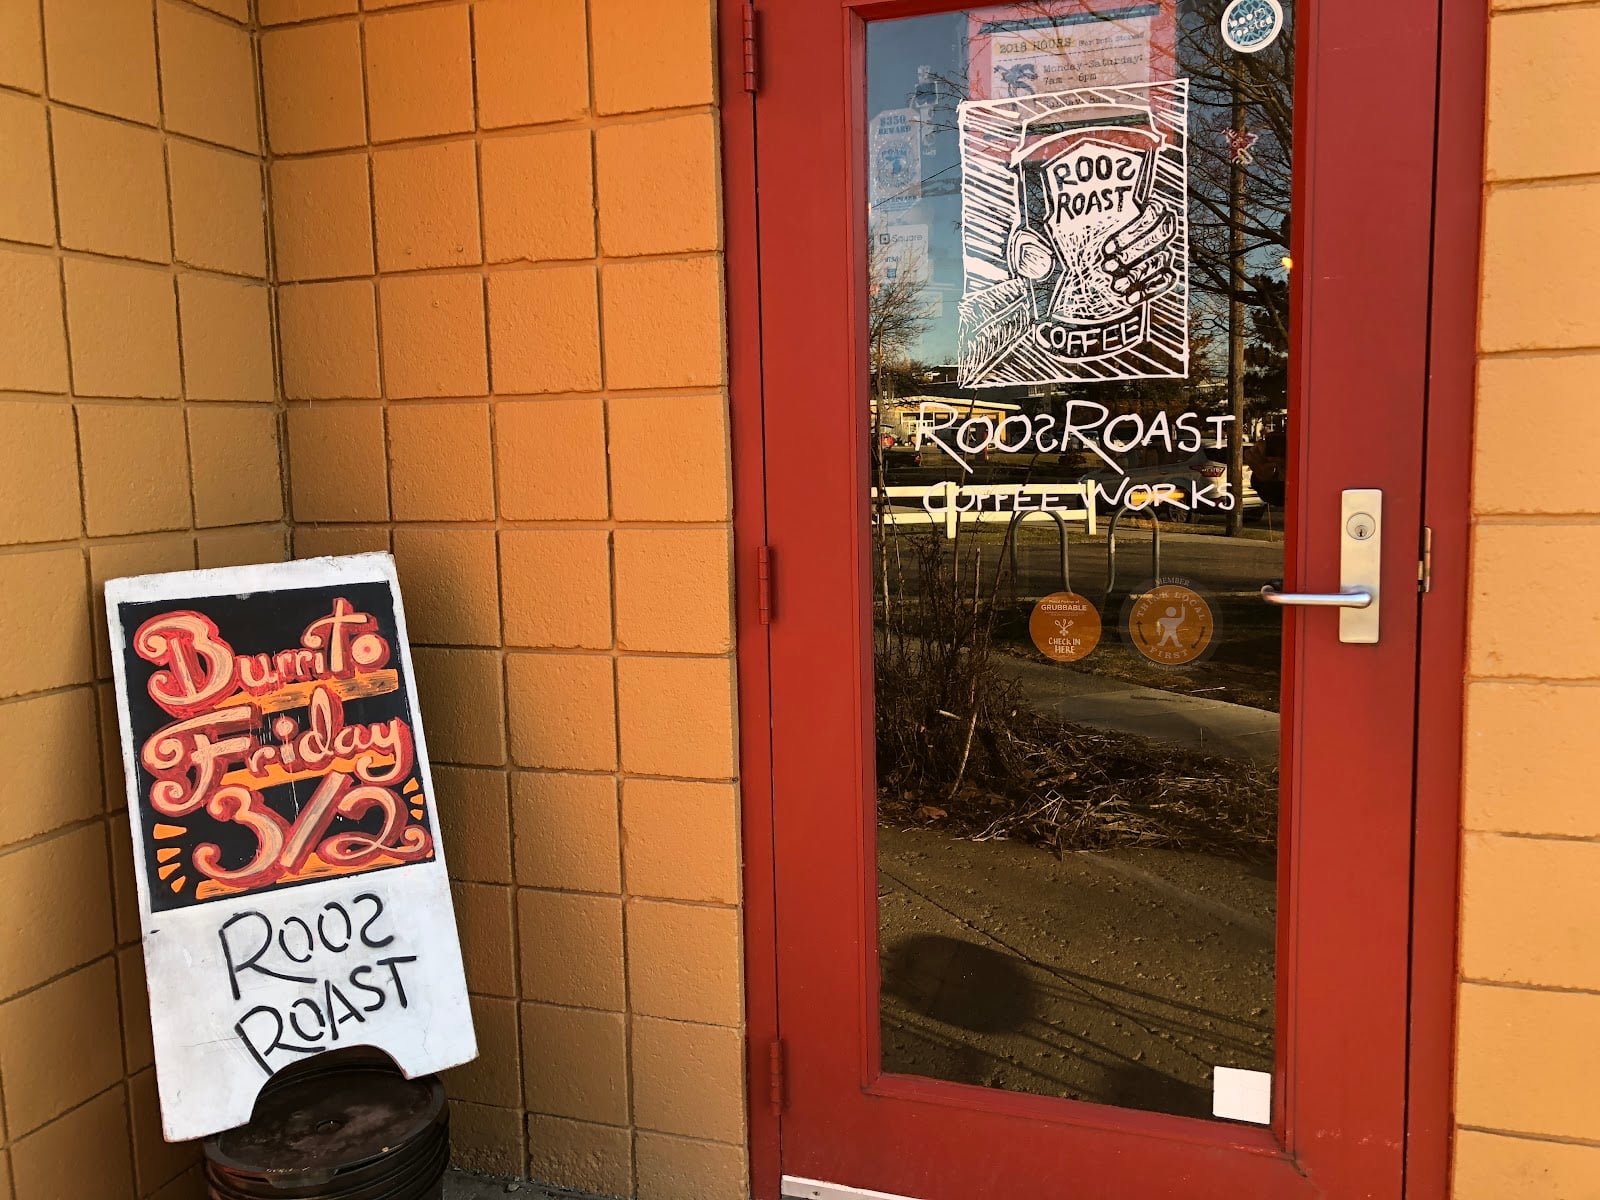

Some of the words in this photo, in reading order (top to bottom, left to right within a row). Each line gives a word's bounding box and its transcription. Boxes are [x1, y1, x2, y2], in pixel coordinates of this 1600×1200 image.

[1228, 7, 1266, 29] boom
[1231, 14, 1273, 41] roasted
[1000, 41, 1027, 54] 2018
[1033, 36, 1073, 51] HOURS
[1043, 76, 1063, 86] 7am
[1078, 72, 1097, 84] 6pm
[878, 126, 912, 135] REWARD
[1052, 154, 1136, 191] ROOS
[1056, 185, 1133, 224] ROAST
[1035, 315, 1140, 355] COFFEE
[922, 480, 1068, 514] COFFEE
[1077, 476, 1235, 513] WORKS
[1154, 576, 1191, 588] MEMBER
[1173, 591, 1206, 621] LOCAL
[1054, 645, 1076, 654] HERE
[1072, 637, 1081, 646] IN
[1149, 647, 1189, 660] FIRST
[133, 597, 390, 720] Burrito
[142, 685, 414, 817] Friday
[193, 771, 432, 888] 3/2
[218, 893, 394, 1000] ROOS
[234, 956, 417, 1076] ROAST
